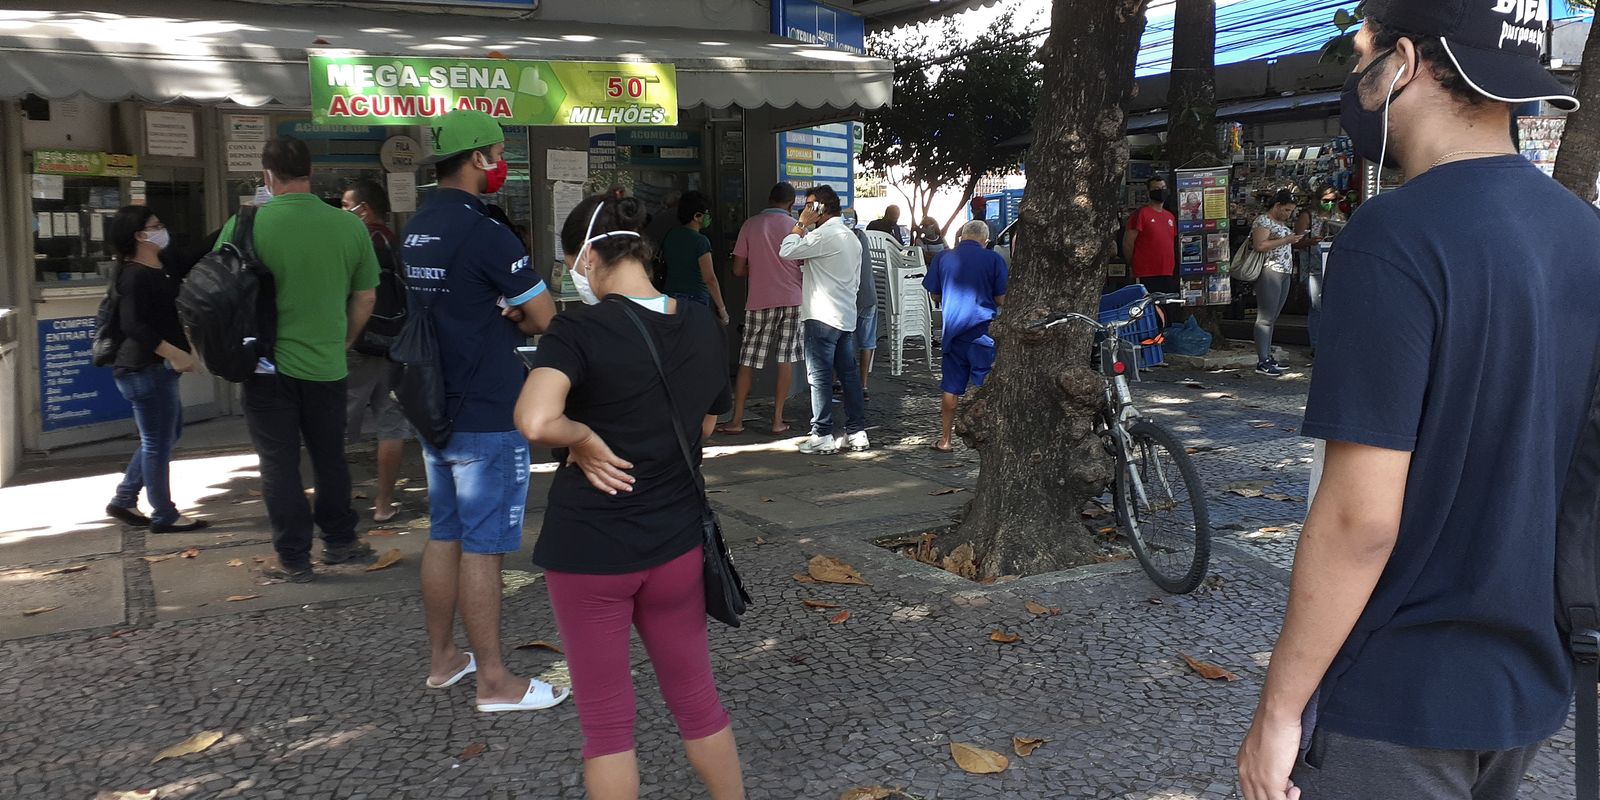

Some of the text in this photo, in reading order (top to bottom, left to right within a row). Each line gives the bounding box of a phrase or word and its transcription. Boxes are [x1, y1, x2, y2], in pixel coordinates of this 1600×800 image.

[327, 65, 511, 89] MEGA-SENA
[606, 76, 643, 98] 50
[328, 96, 512, 118] ACUMULADA
[568, 104, 666, 124] MILHÕES
[53, 318, 96, 330] COMPRE
[46, 331, 87, 343] ENTRAR
